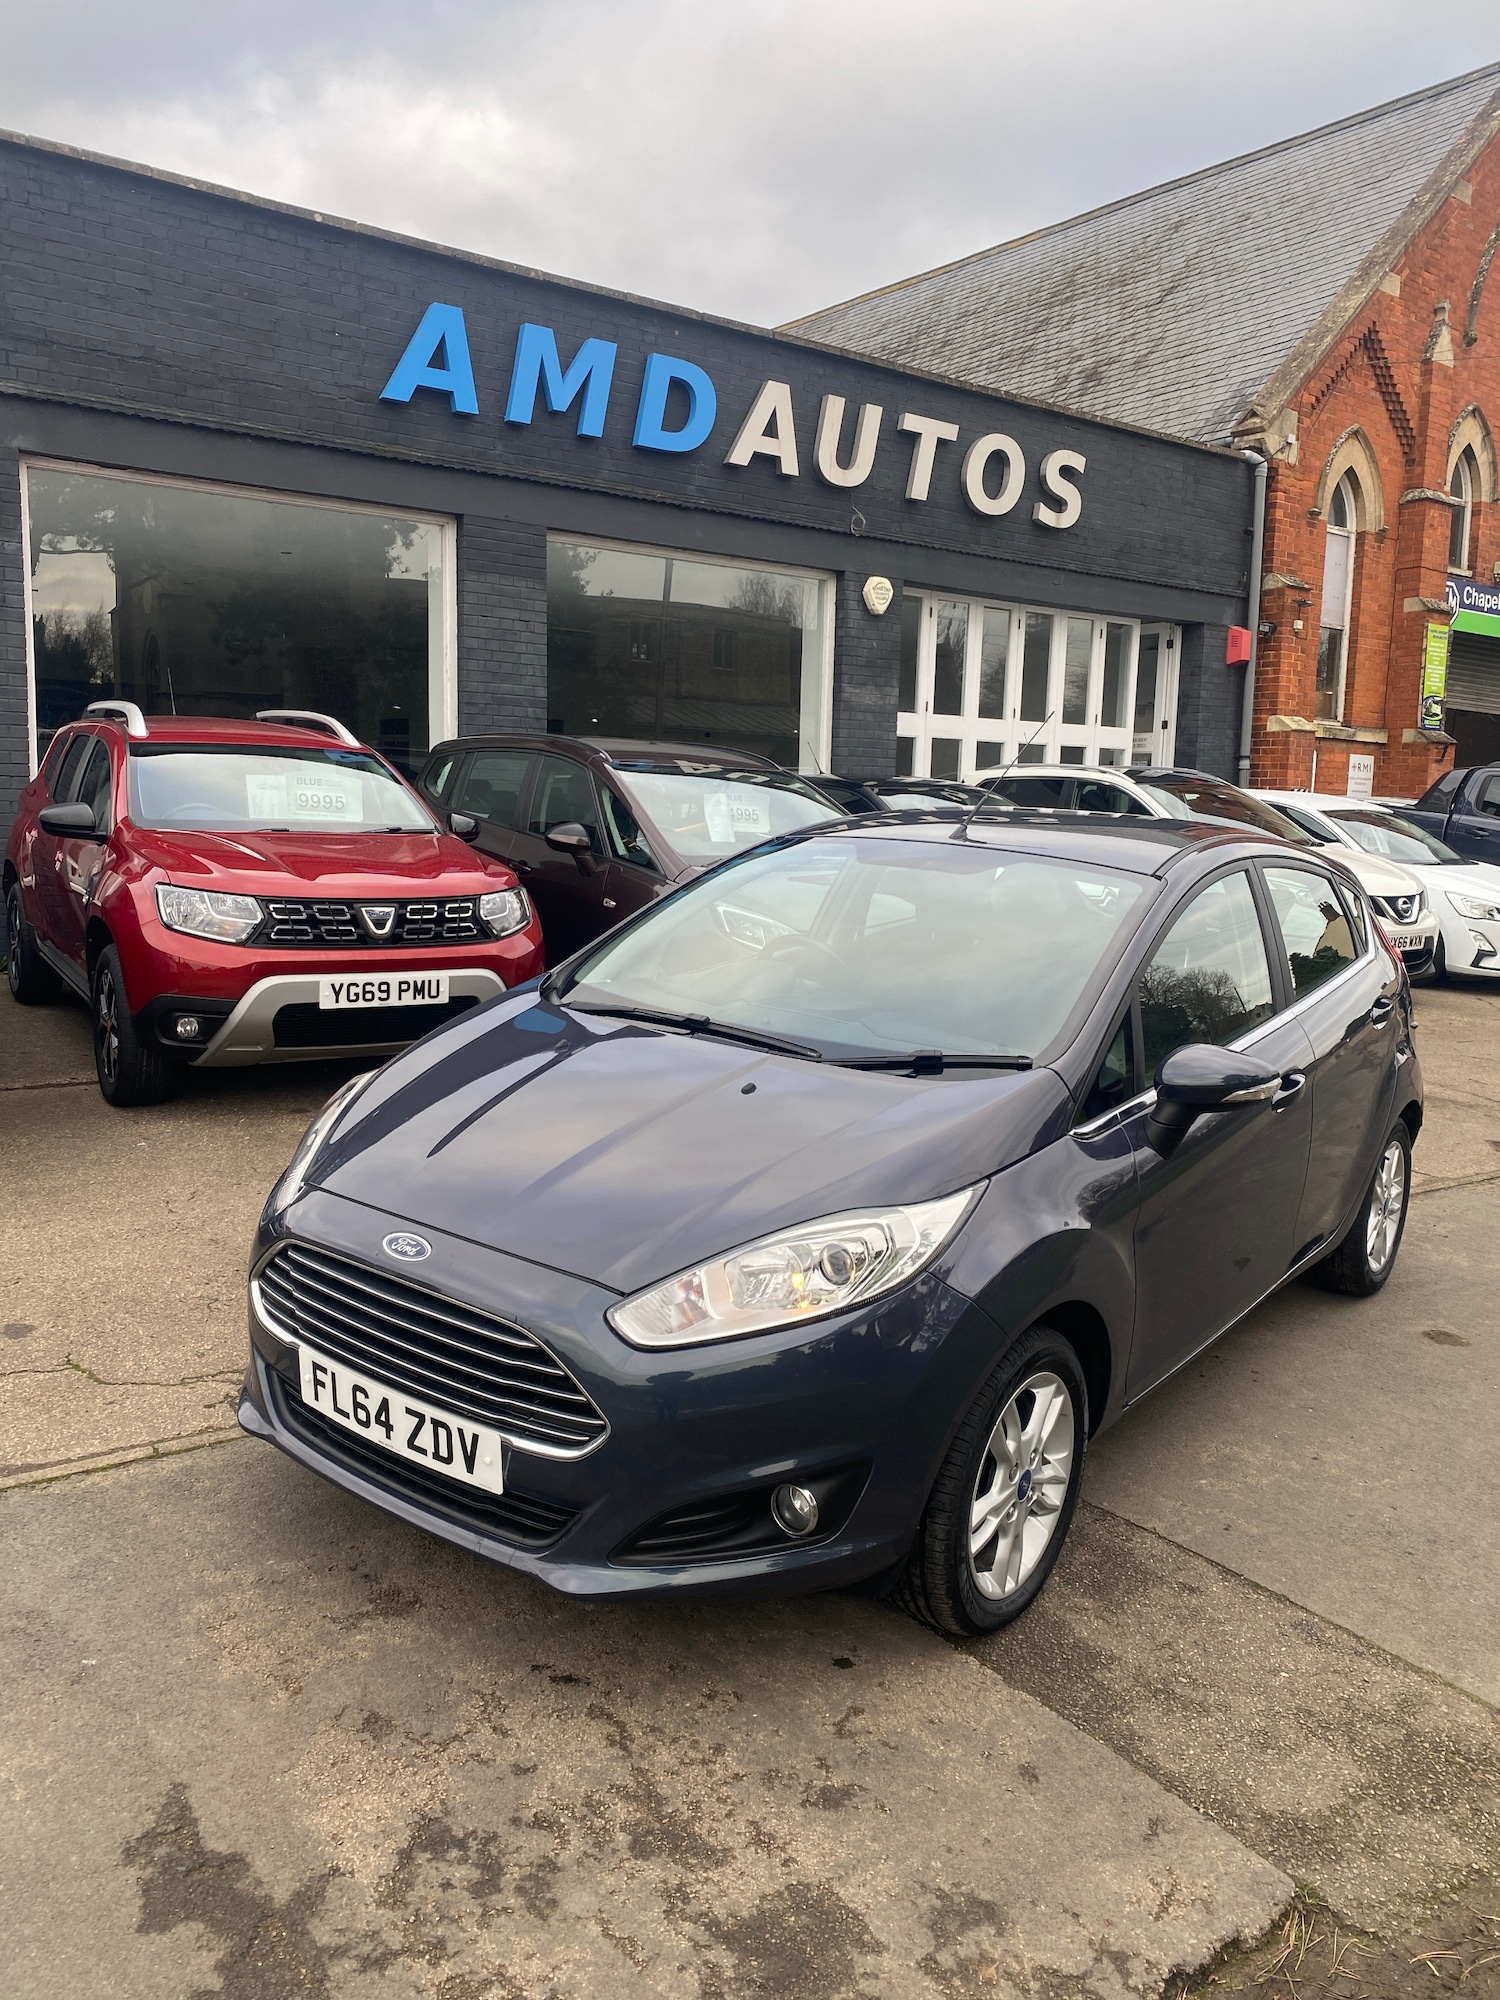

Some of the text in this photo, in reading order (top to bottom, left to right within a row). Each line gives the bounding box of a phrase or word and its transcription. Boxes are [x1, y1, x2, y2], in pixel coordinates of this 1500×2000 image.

[379, 301, 1087, 529] AMD AUTOS
[1357, 762, 1372, 773] RMI
[296, 777, 323, 787] BLUE
[298, 794, 345, 811] 9995
[730, 807, 759, 822] 4995
[1409, 934, 1424, 948] WXN
[330, 979, 440, 1004] YG69 PMU
[391, 1237, 421, 1256] Ford
[312, 1360, 480, 1475] FL64 ZDV
